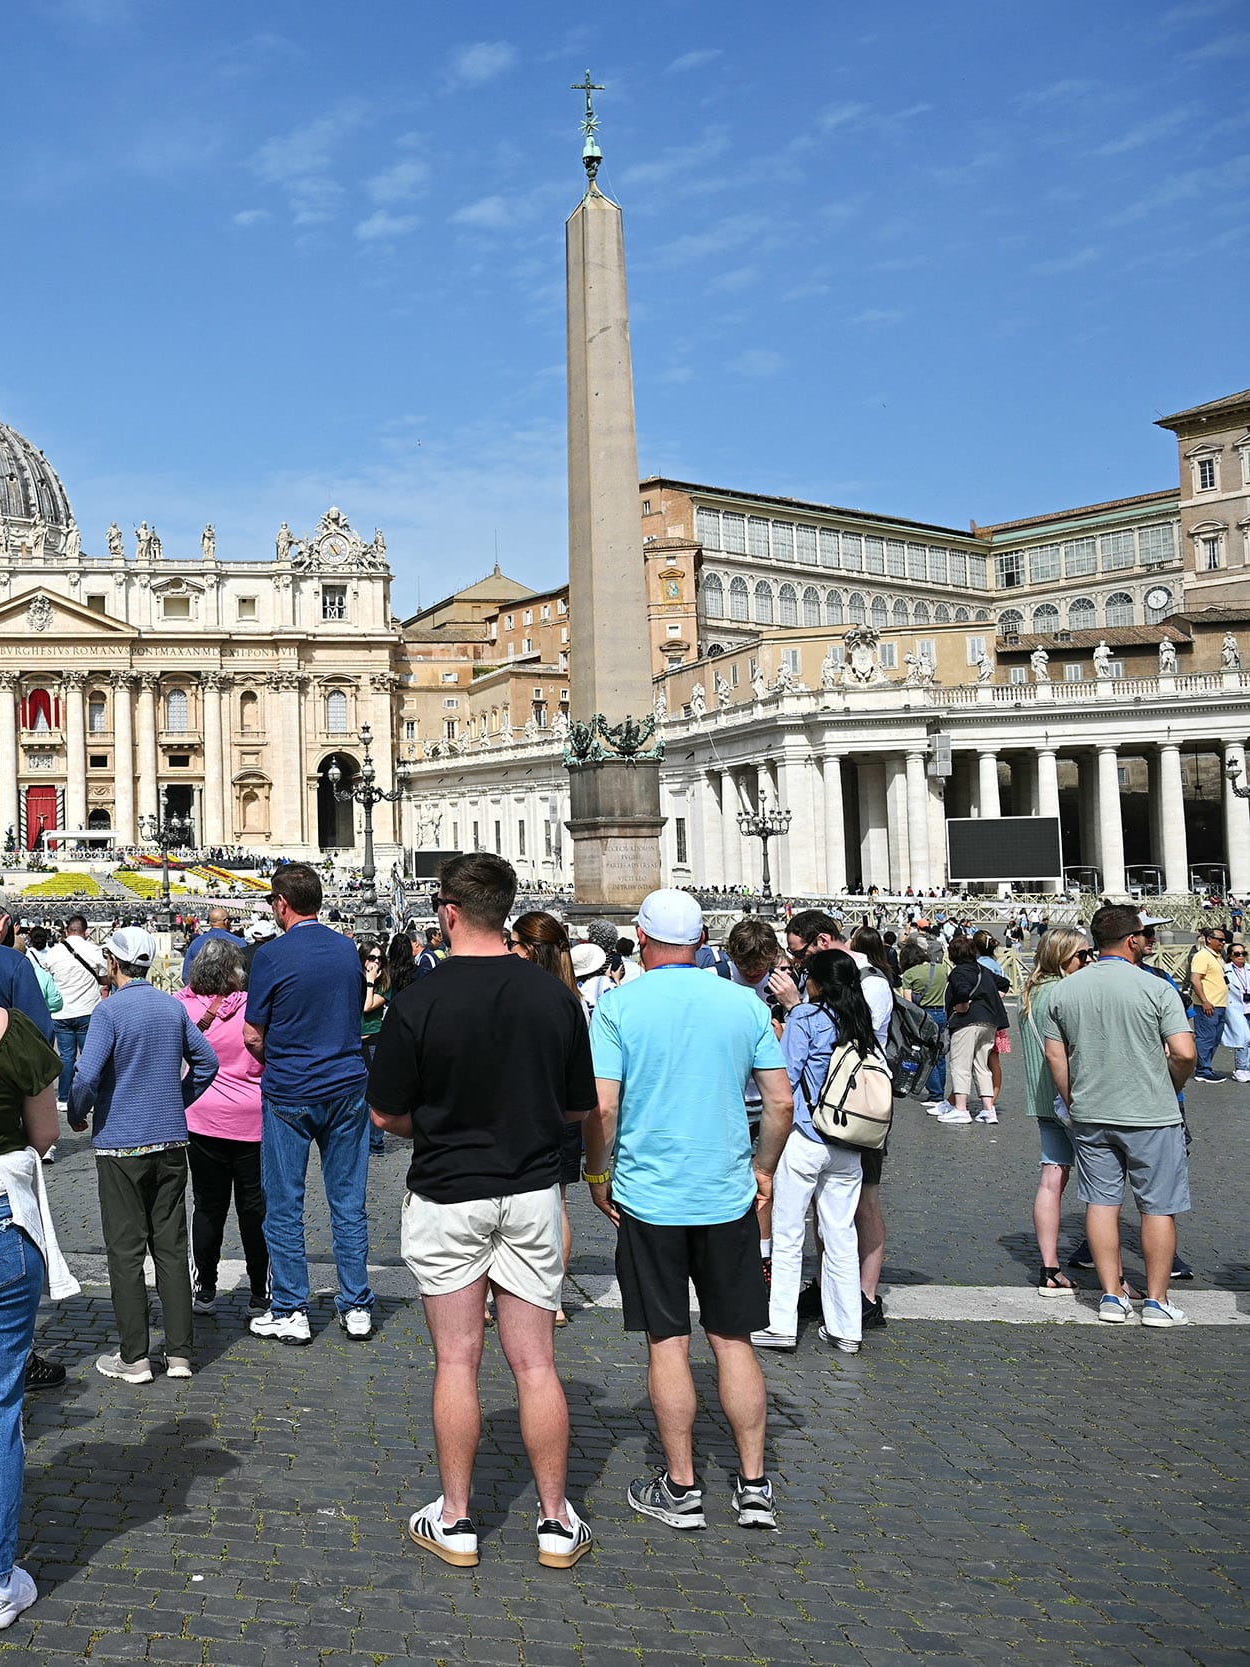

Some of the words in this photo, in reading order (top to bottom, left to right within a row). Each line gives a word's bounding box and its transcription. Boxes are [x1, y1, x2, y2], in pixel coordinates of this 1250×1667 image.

[0, 646, 70, 656] BVRGHESIVS
[73, 646, 129, 656] ROMANVS
[280, 647, 297, 656] VII
